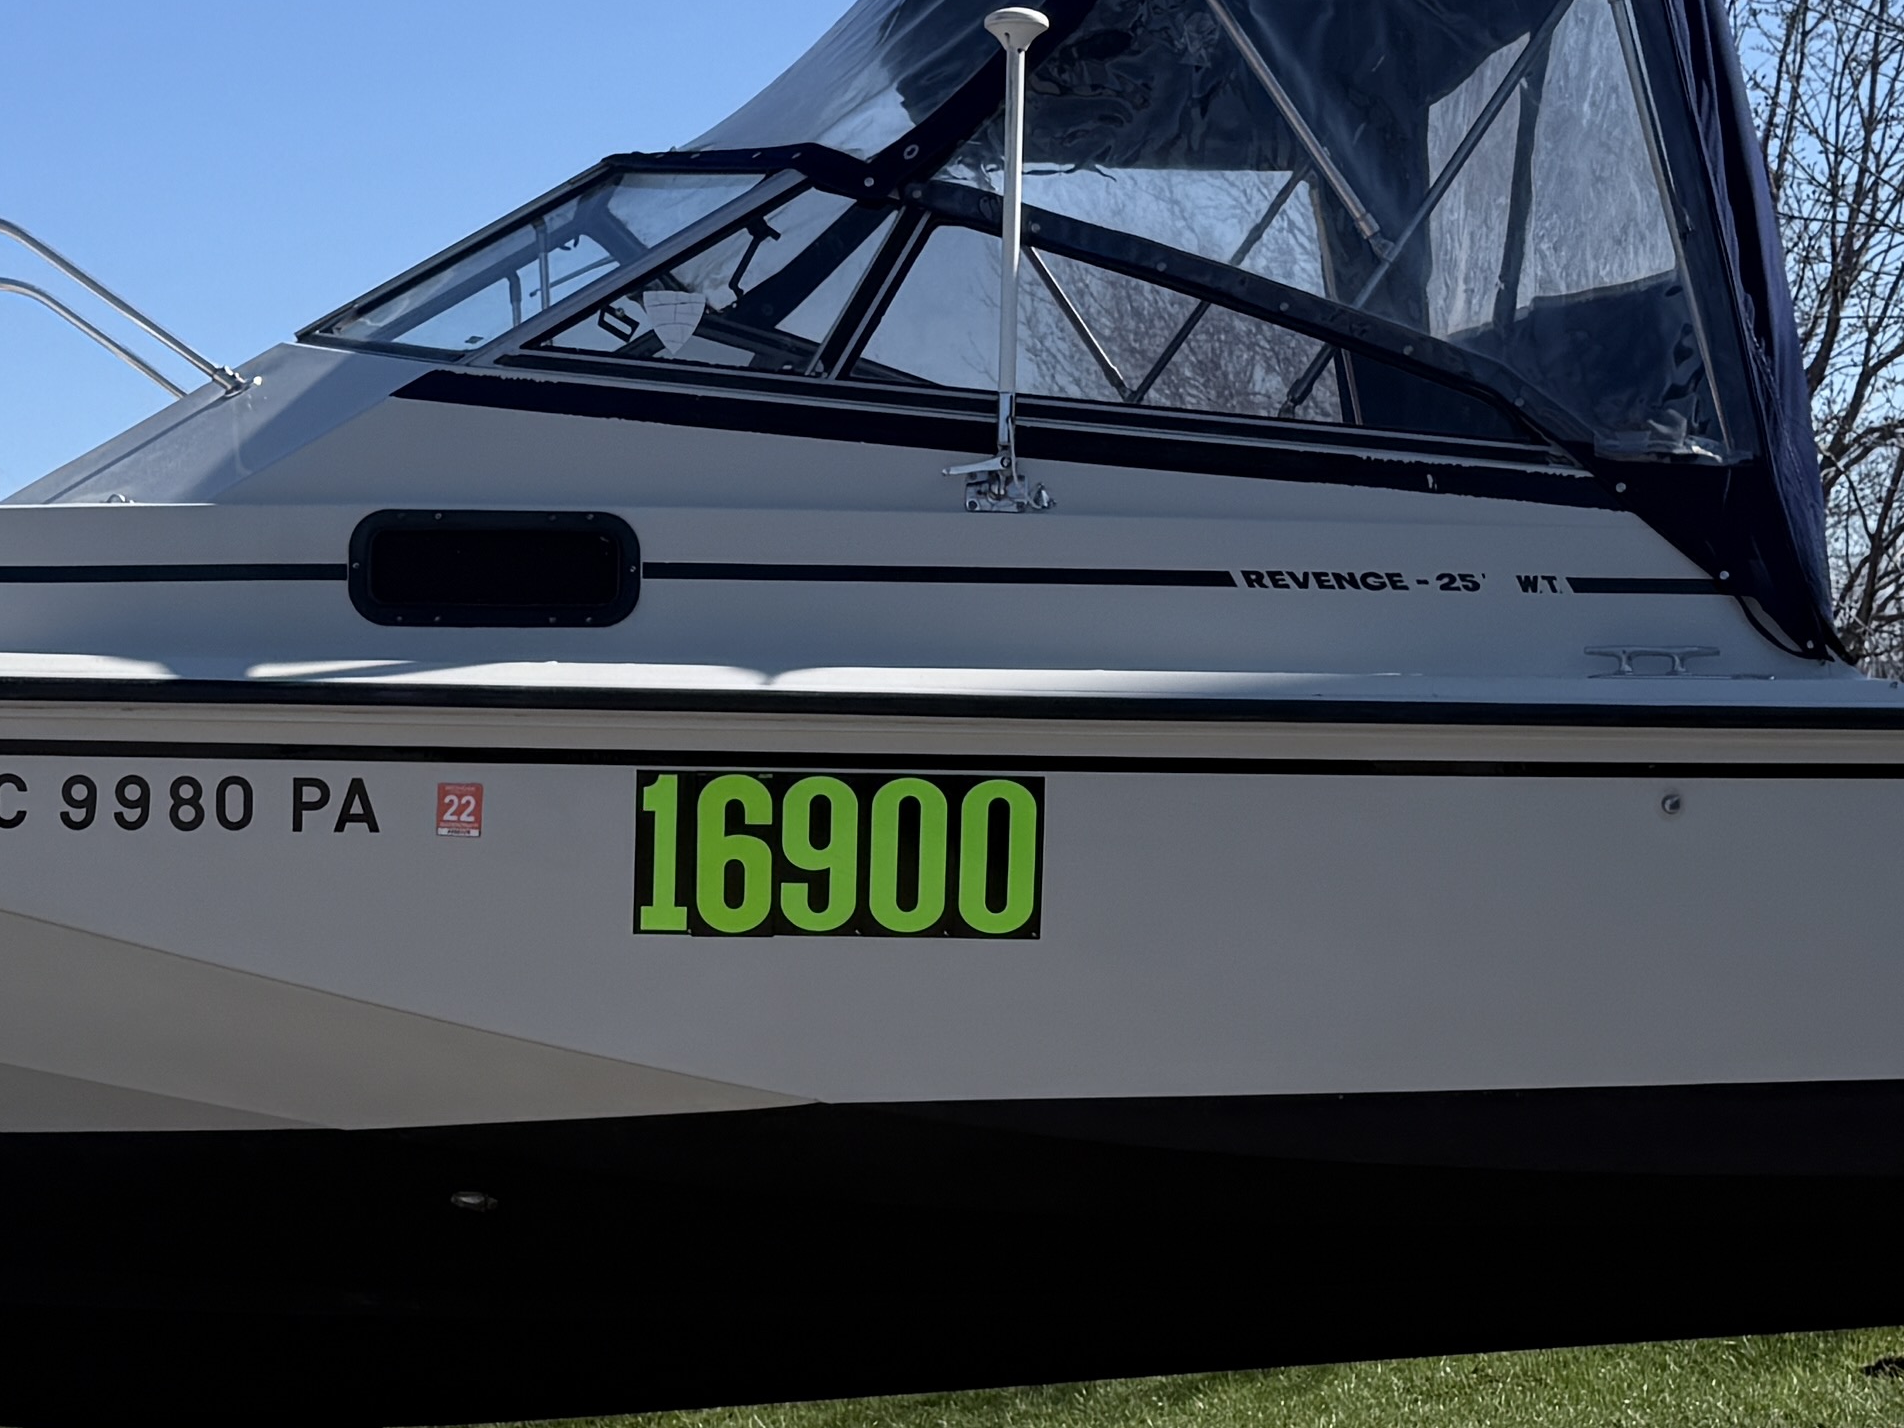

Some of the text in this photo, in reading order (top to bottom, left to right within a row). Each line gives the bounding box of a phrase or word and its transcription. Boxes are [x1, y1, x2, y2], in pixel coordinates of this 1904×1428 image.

[1240, 569, 1409, 592] REVENGE
[60, 774, 254, 831] 9980
[293, 777, 381, 834] PA
[443, 794, 476, 822] 22
[639, 773, 1038, 934] 16900
